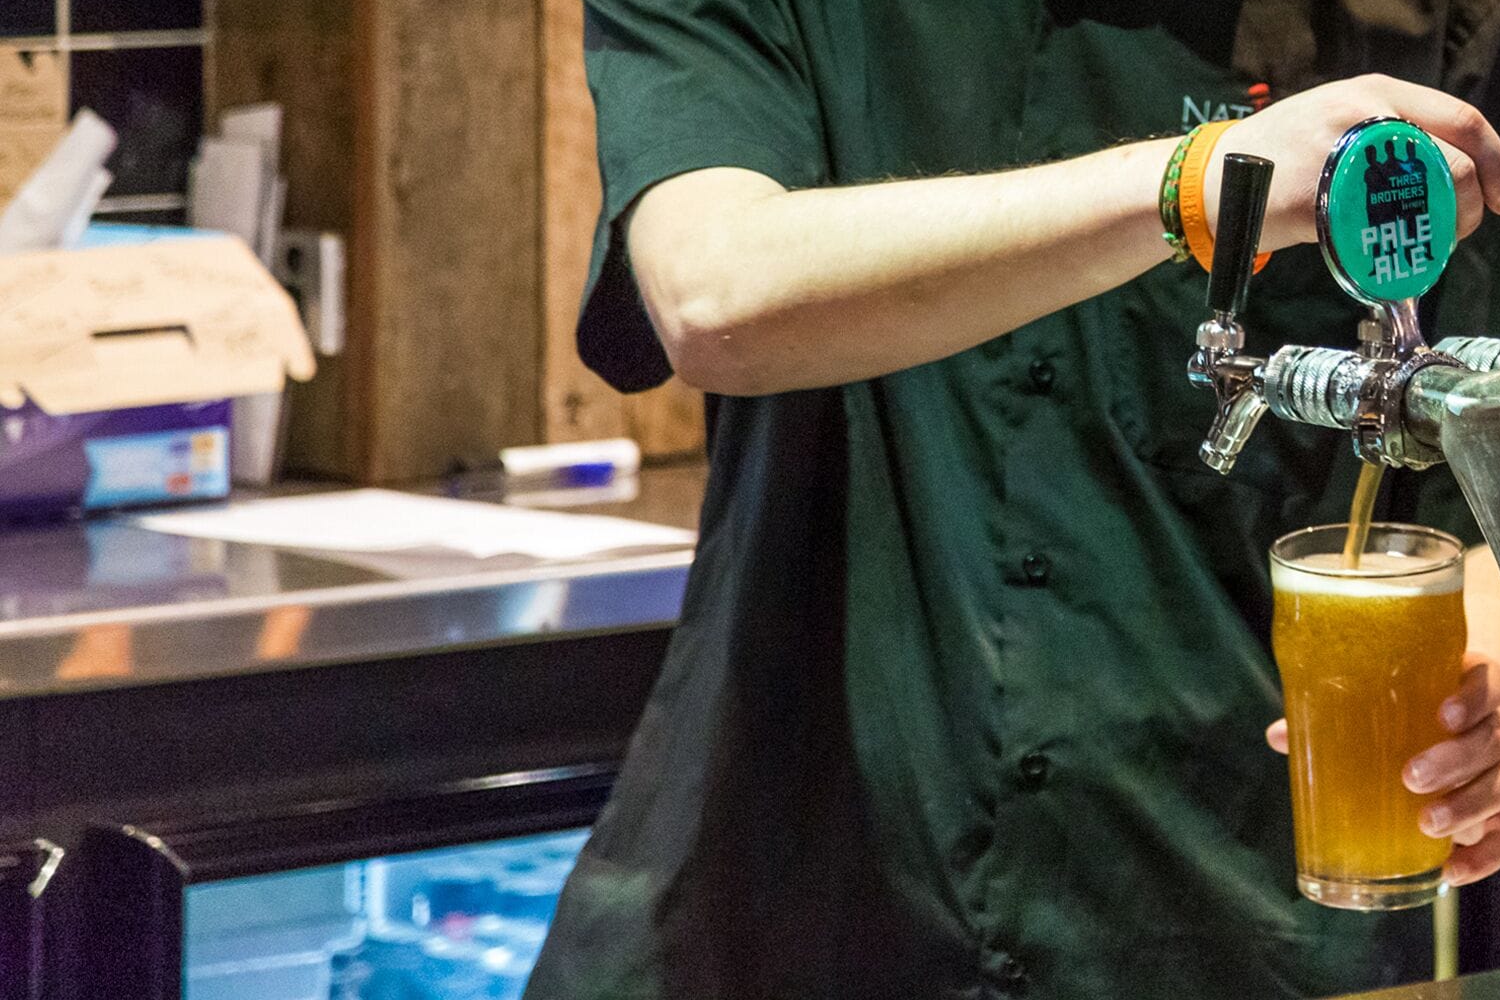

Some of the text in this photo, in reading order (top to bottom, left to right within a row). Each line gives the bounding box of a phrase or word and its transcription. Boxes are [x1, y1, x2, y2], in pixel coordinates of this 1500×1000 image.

[1389, 173, 1423, 188] THREE
[1370, 186, 1425, 205] BROTHERS
[1361, 213, 1432, 256] PALE
[1374, 246, 1427, 285] ALE
